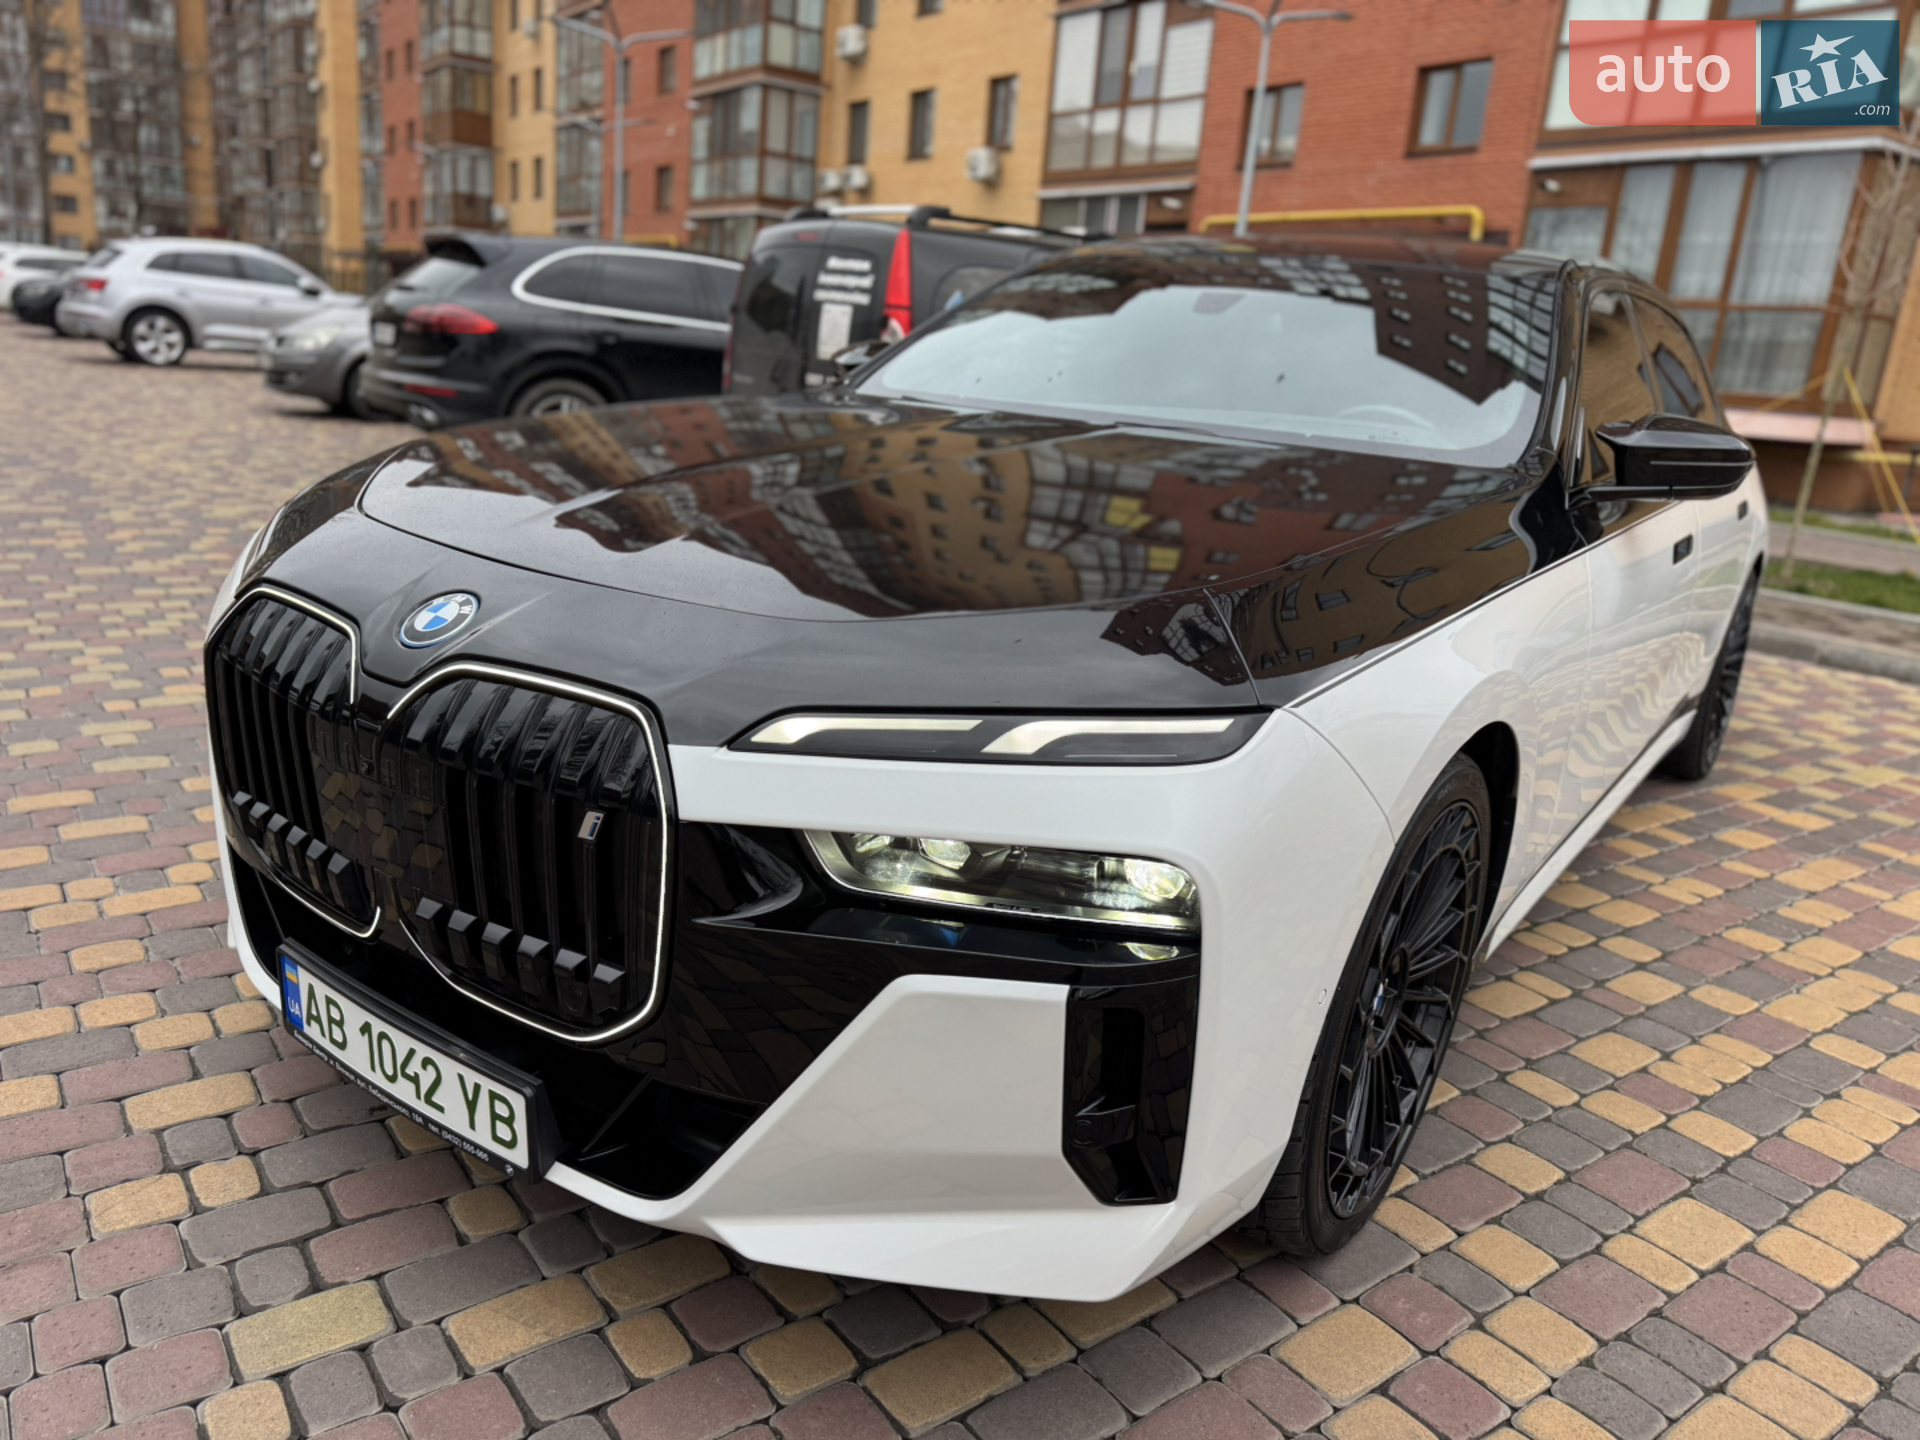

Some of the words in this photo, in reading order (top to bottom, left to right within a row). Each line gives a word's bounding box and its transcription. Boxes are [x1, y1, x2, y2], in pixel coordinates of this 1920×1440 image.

[287, 996, 301, 1018] UA
[305, 982, 348, 1052] AB
[358, 1020, 445, 1114] 1042
[457, 1072, 518, 1150] YB
